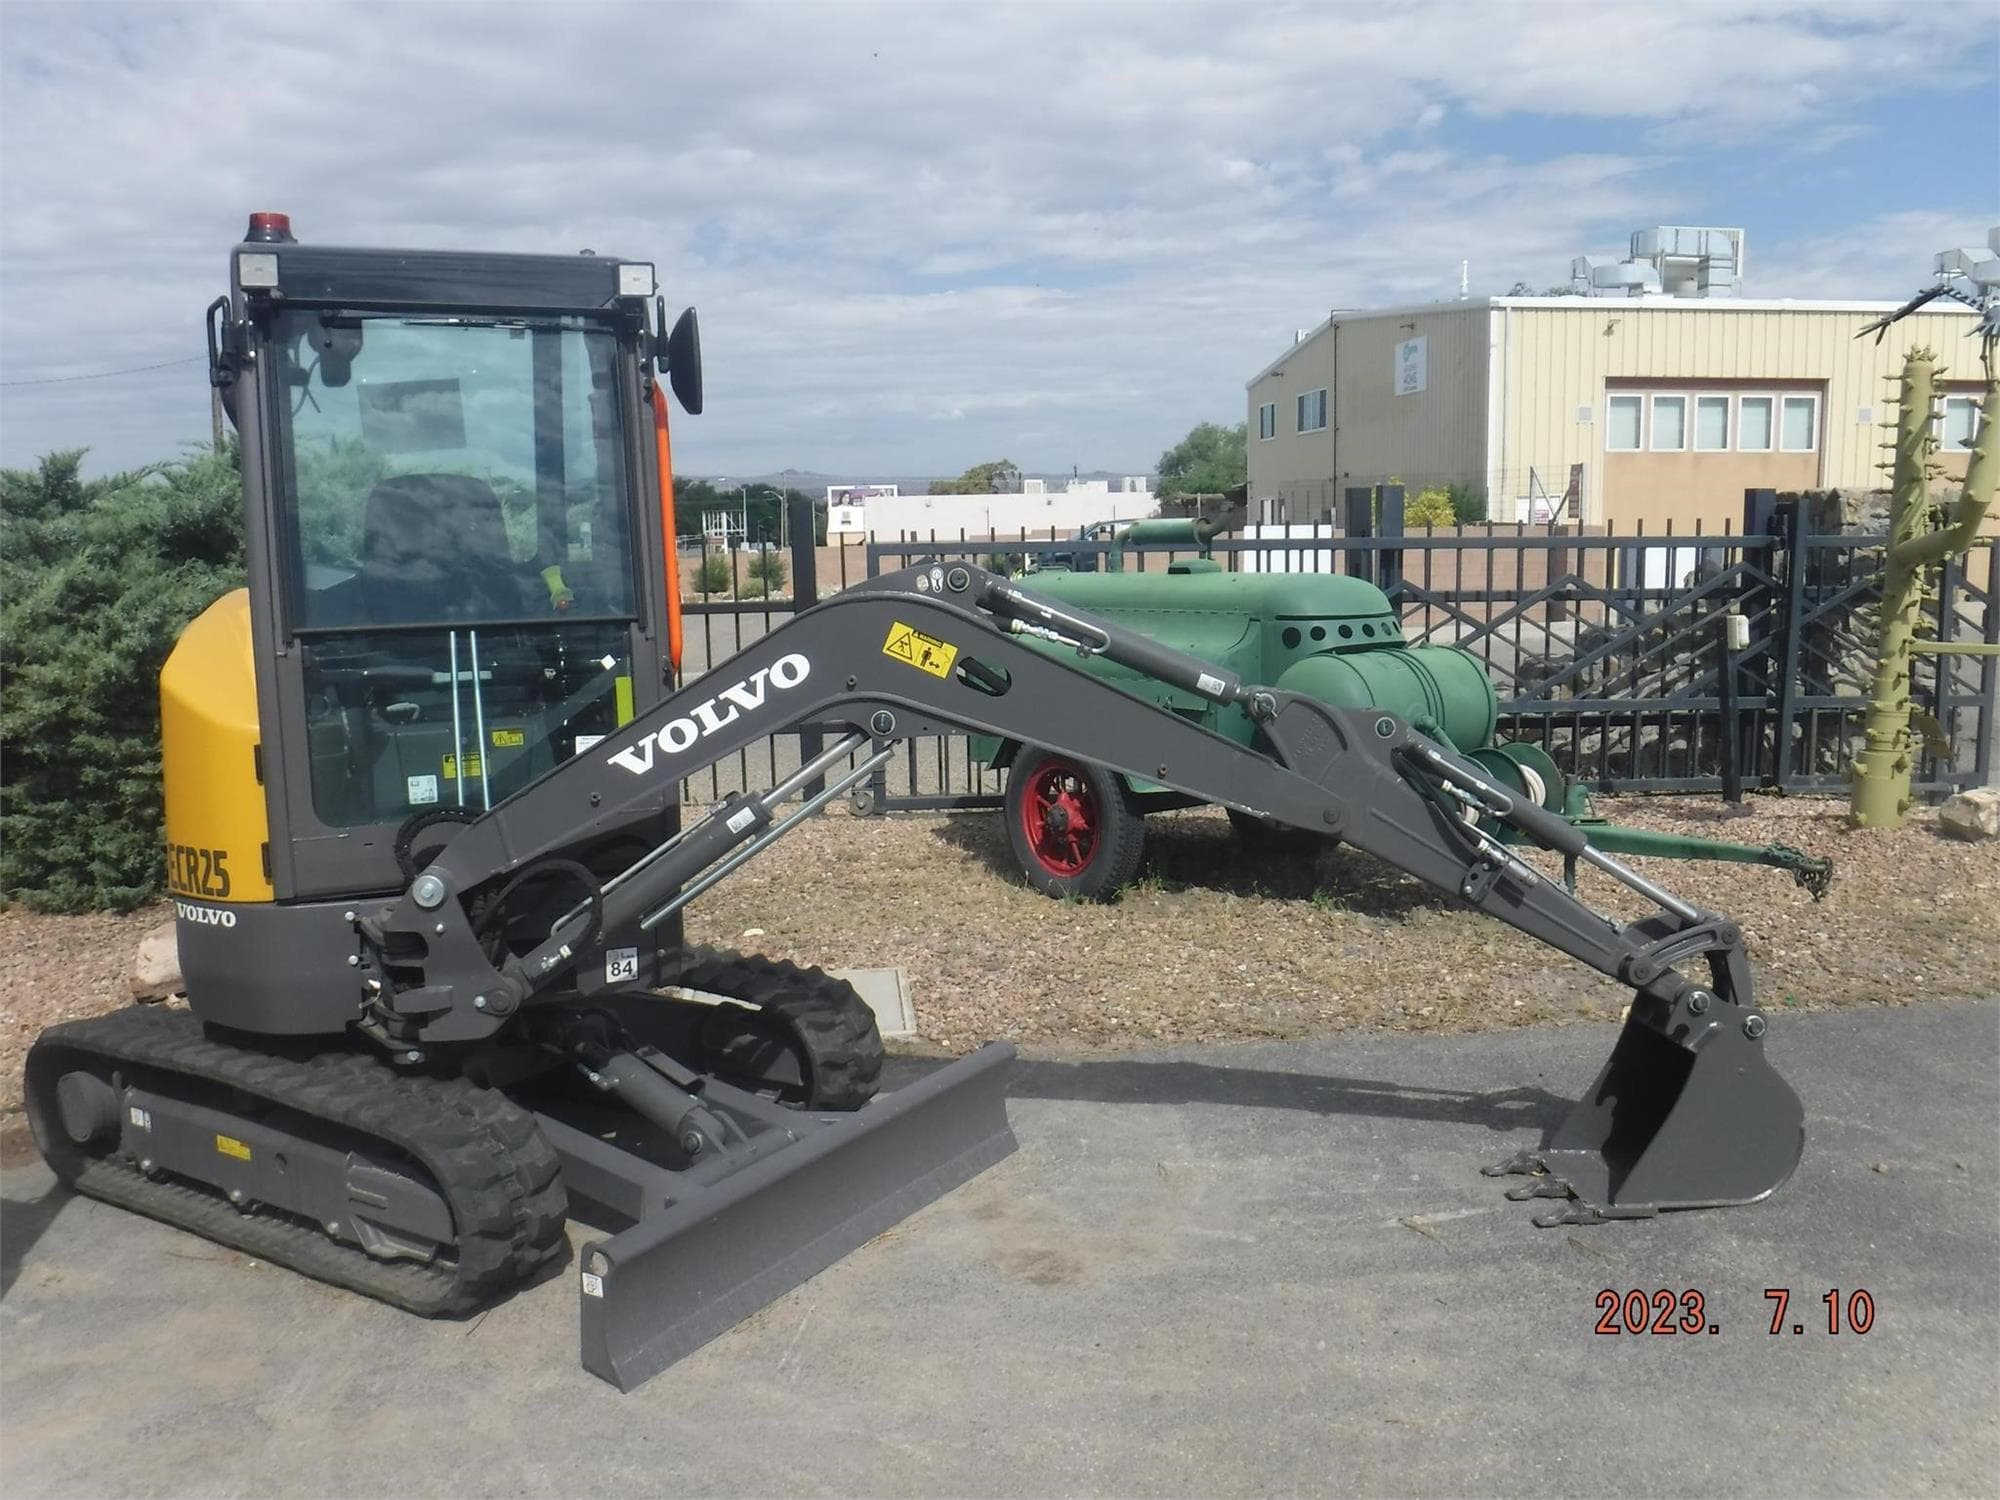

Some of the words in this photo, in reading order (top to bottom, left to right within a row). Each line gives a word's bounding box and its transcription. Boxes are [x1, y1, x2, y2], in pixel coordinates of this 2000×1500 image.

[606, 653, 811, 775] VOLVO
[168, 843, 231, 897] ECR25
[176, 902, 237, 928] VOLVO
[611, 960, 633, 977] 84
